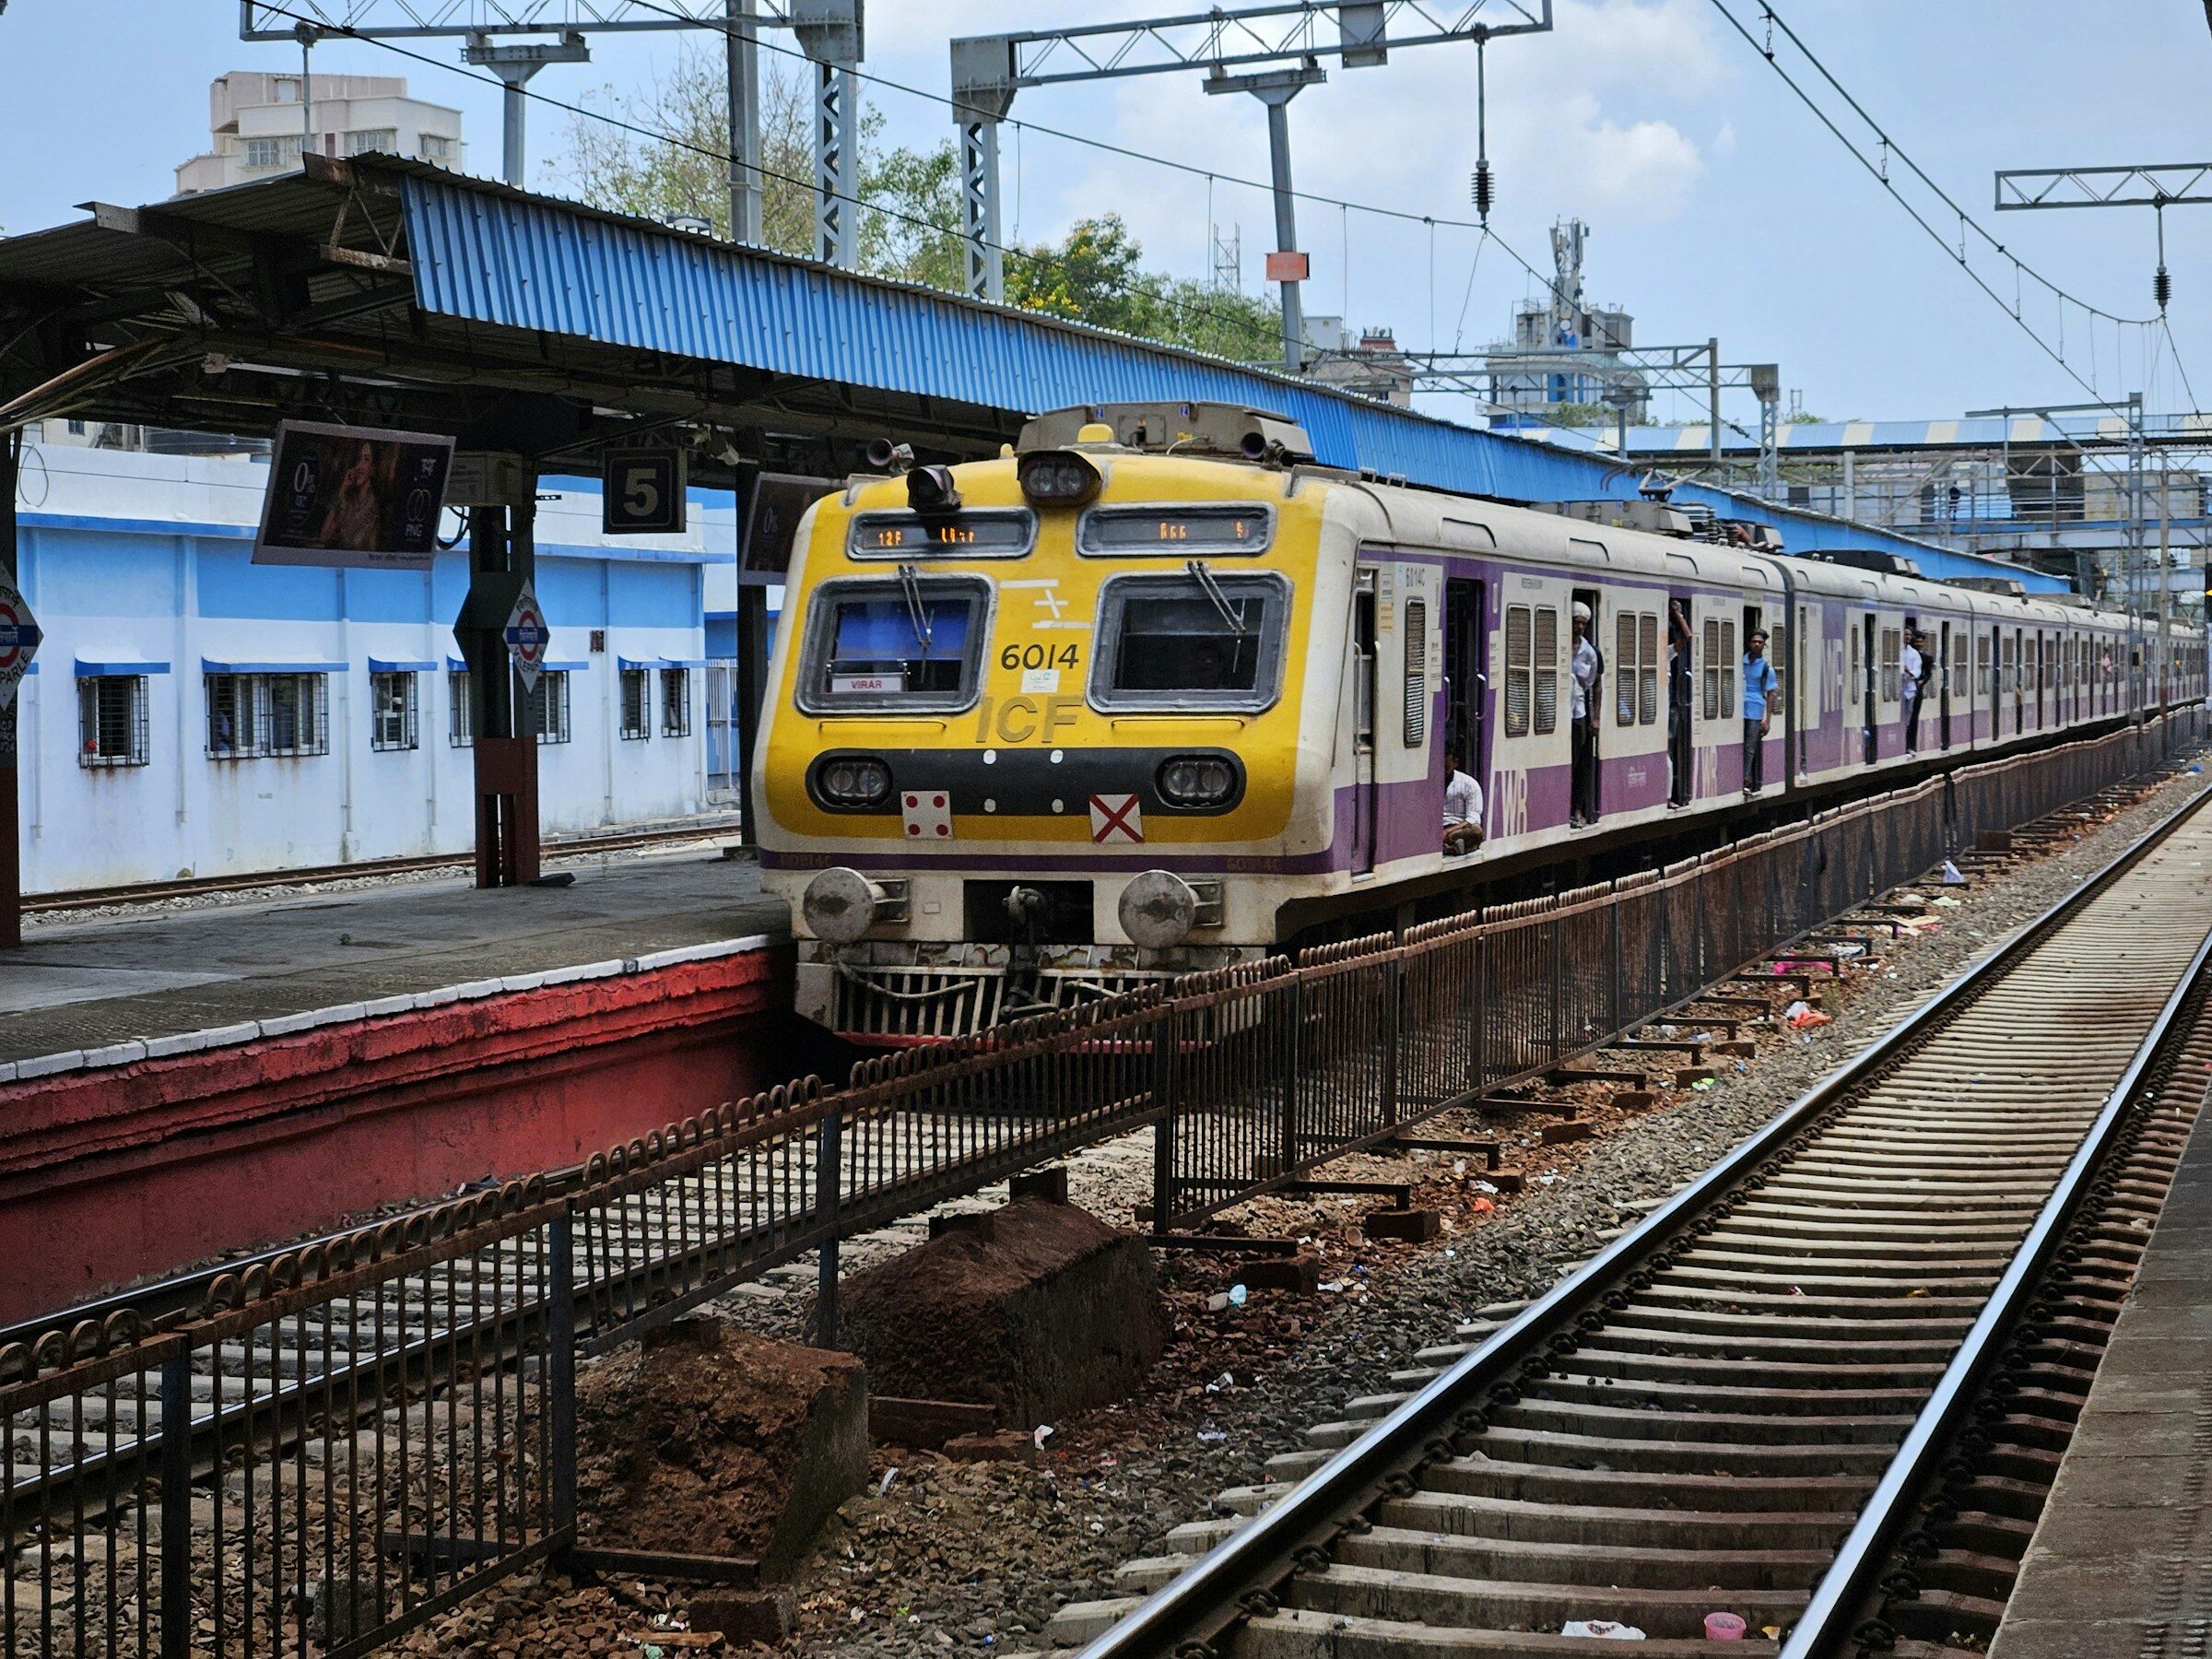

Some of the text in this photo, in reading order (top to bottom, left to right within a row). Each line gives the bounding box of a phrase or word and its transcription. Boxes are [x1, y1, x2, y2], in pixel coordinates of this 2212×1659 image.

[623, 468, 658, 516] 5
[1406, 567, 1426, 588] 6014C
[1001, 644, 1079, 670] 6014
[851, 680, 882, 689] VIRAR
[975, 696, 1084, 744] ICF
[1500, 769, 1528, 839] WR
